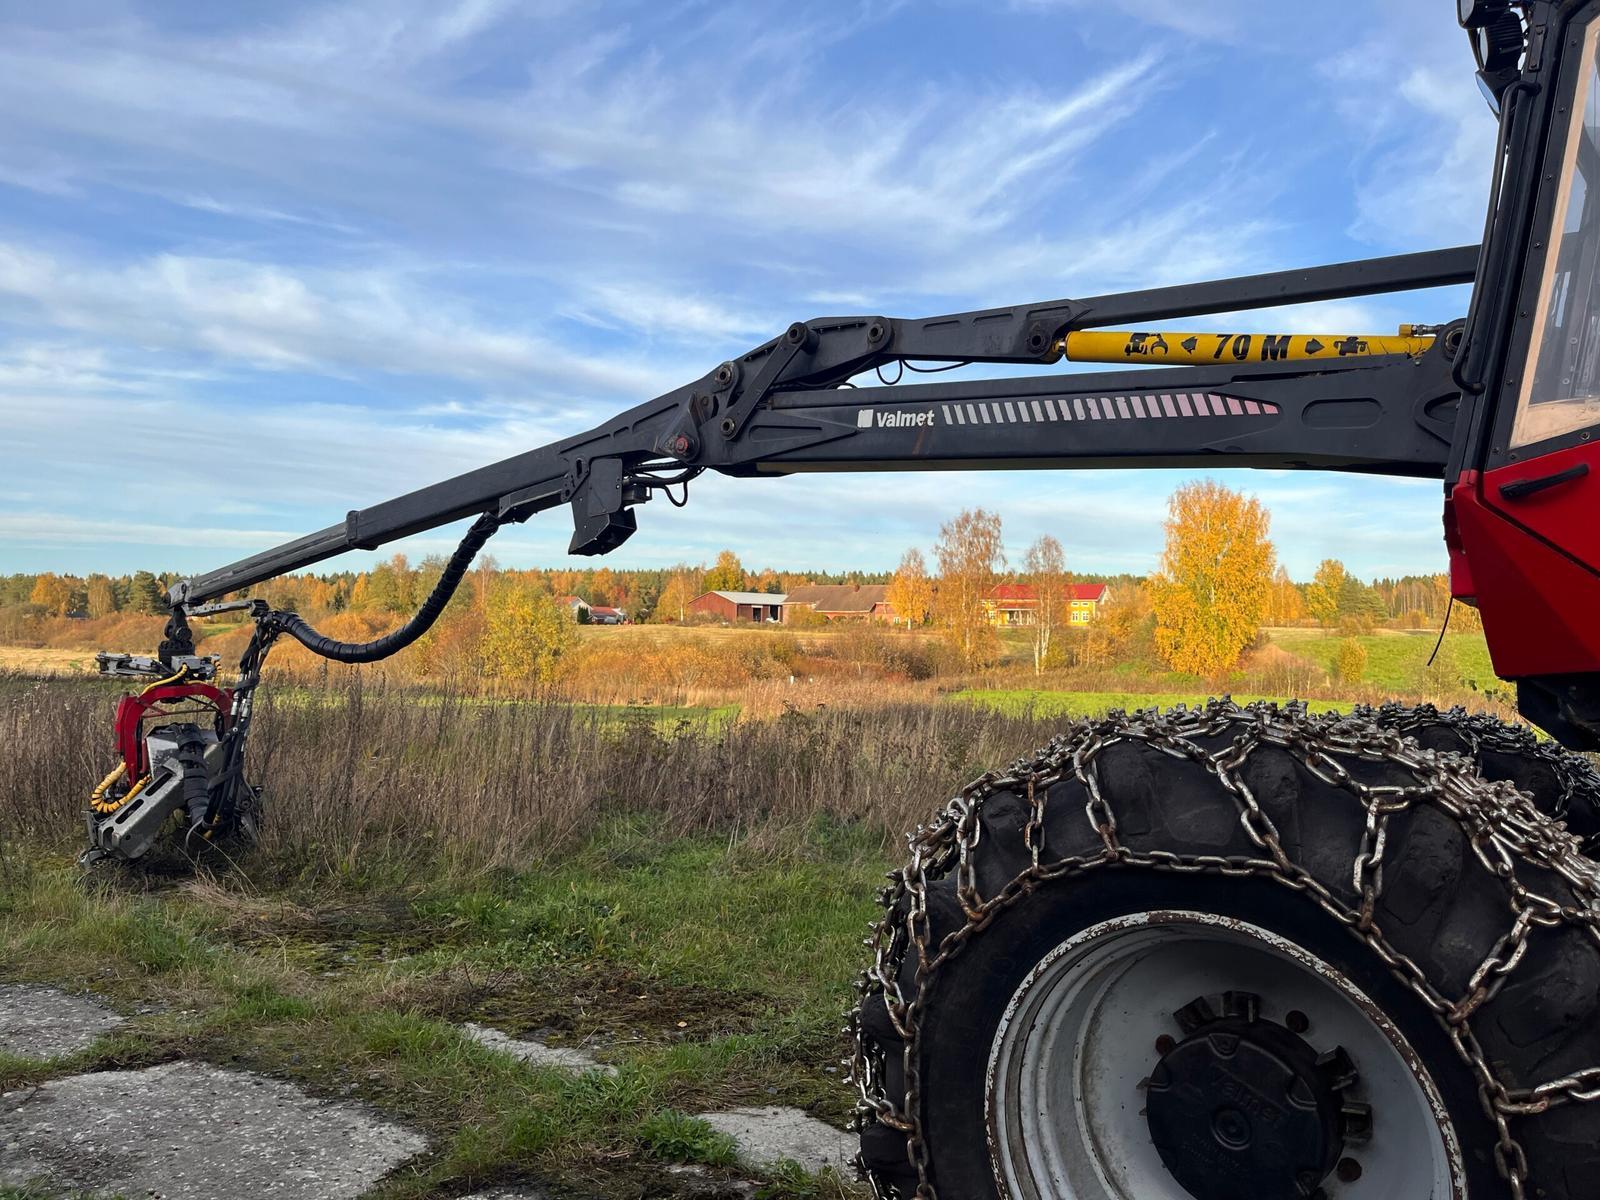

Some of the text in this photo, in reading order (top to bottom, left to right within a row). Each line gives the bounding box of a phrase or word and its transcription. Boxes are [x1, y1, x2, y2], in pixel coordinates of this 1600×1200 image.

[1213, 333, 1293, 361] 70 M
[876, 409, 935, 428] Valmet
